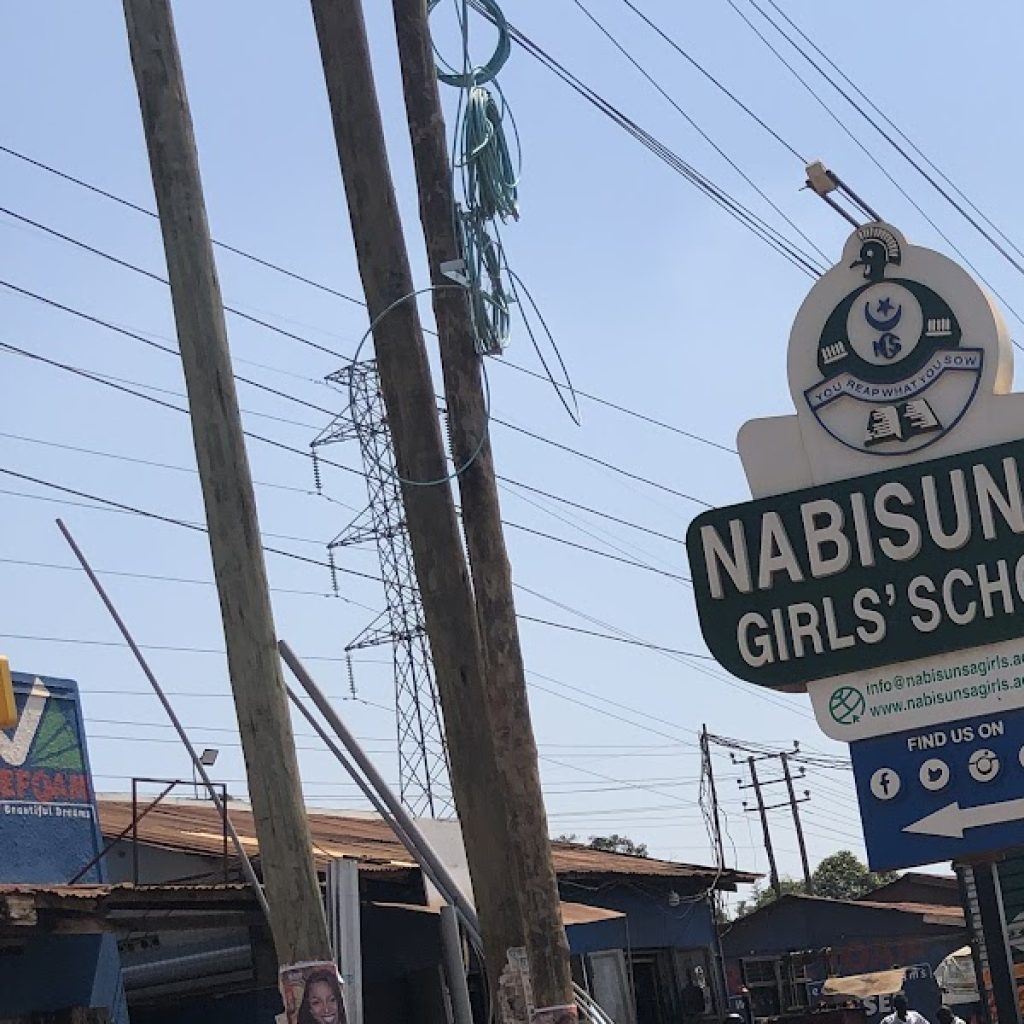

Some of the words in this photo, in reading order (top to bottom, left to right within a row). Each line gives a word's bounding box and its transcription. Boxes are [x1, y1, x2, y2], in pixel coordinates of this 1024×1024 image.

[815, 382, 842, 402] YOU
[846, 380, 880, 398] REAP
[882, 382, 917, 398] WHAT
[919, 359, 942, 385] YOU
[943, 355, 977, 367] SOW
[907, 731, 947, 752] FIND
[951, 725, 975, 745] US
[977, 720, 1005, 740] ON
[4, 804, 52, 818] Beautiful
[55, 806, 91, 819] Dreams
